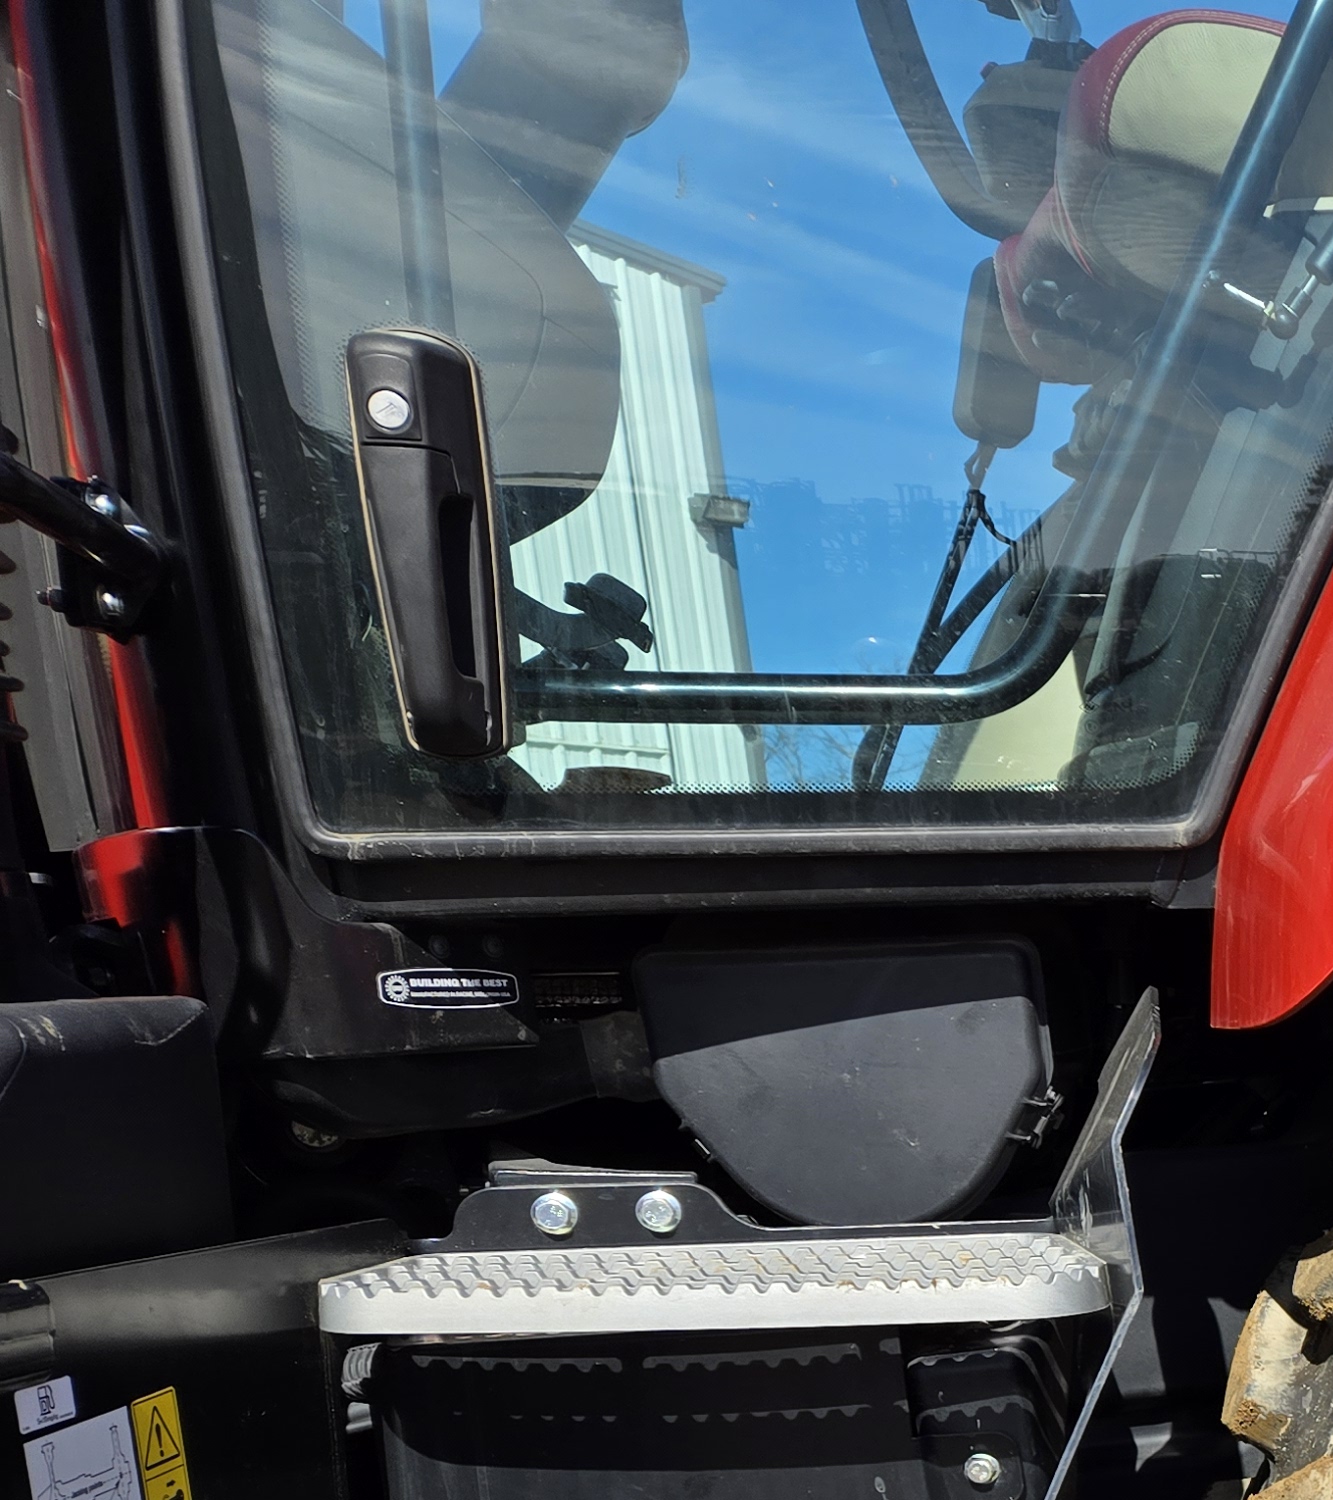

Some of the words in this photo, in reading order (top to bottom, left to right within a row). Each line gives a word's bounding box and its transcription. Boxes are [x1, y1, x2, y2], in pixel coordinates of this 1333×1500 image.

[409, 978, 460, 987] BUILDING
[461, 978, 481, 987] THE
[483, 979, 508, 987] BEST
